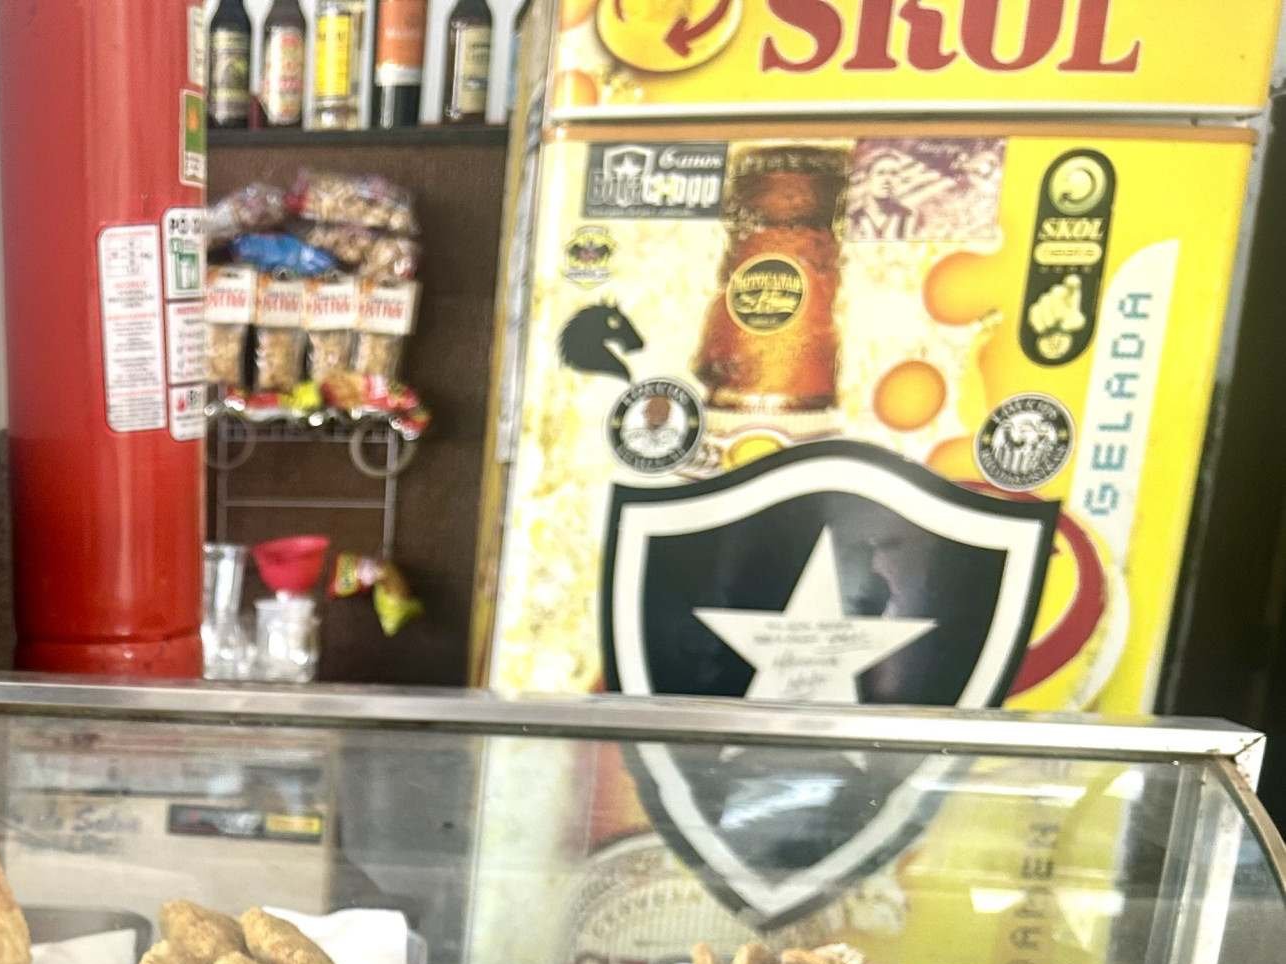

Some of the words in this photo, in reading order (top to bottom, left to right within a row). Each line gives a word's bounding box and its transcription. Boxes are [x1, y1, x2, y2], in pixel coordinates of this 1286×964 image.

[761, 0, 1142, 73] SKOL
[1037, 217, 1105, 240] SKOL
[1083, 292, 1153, 517] GELADA
